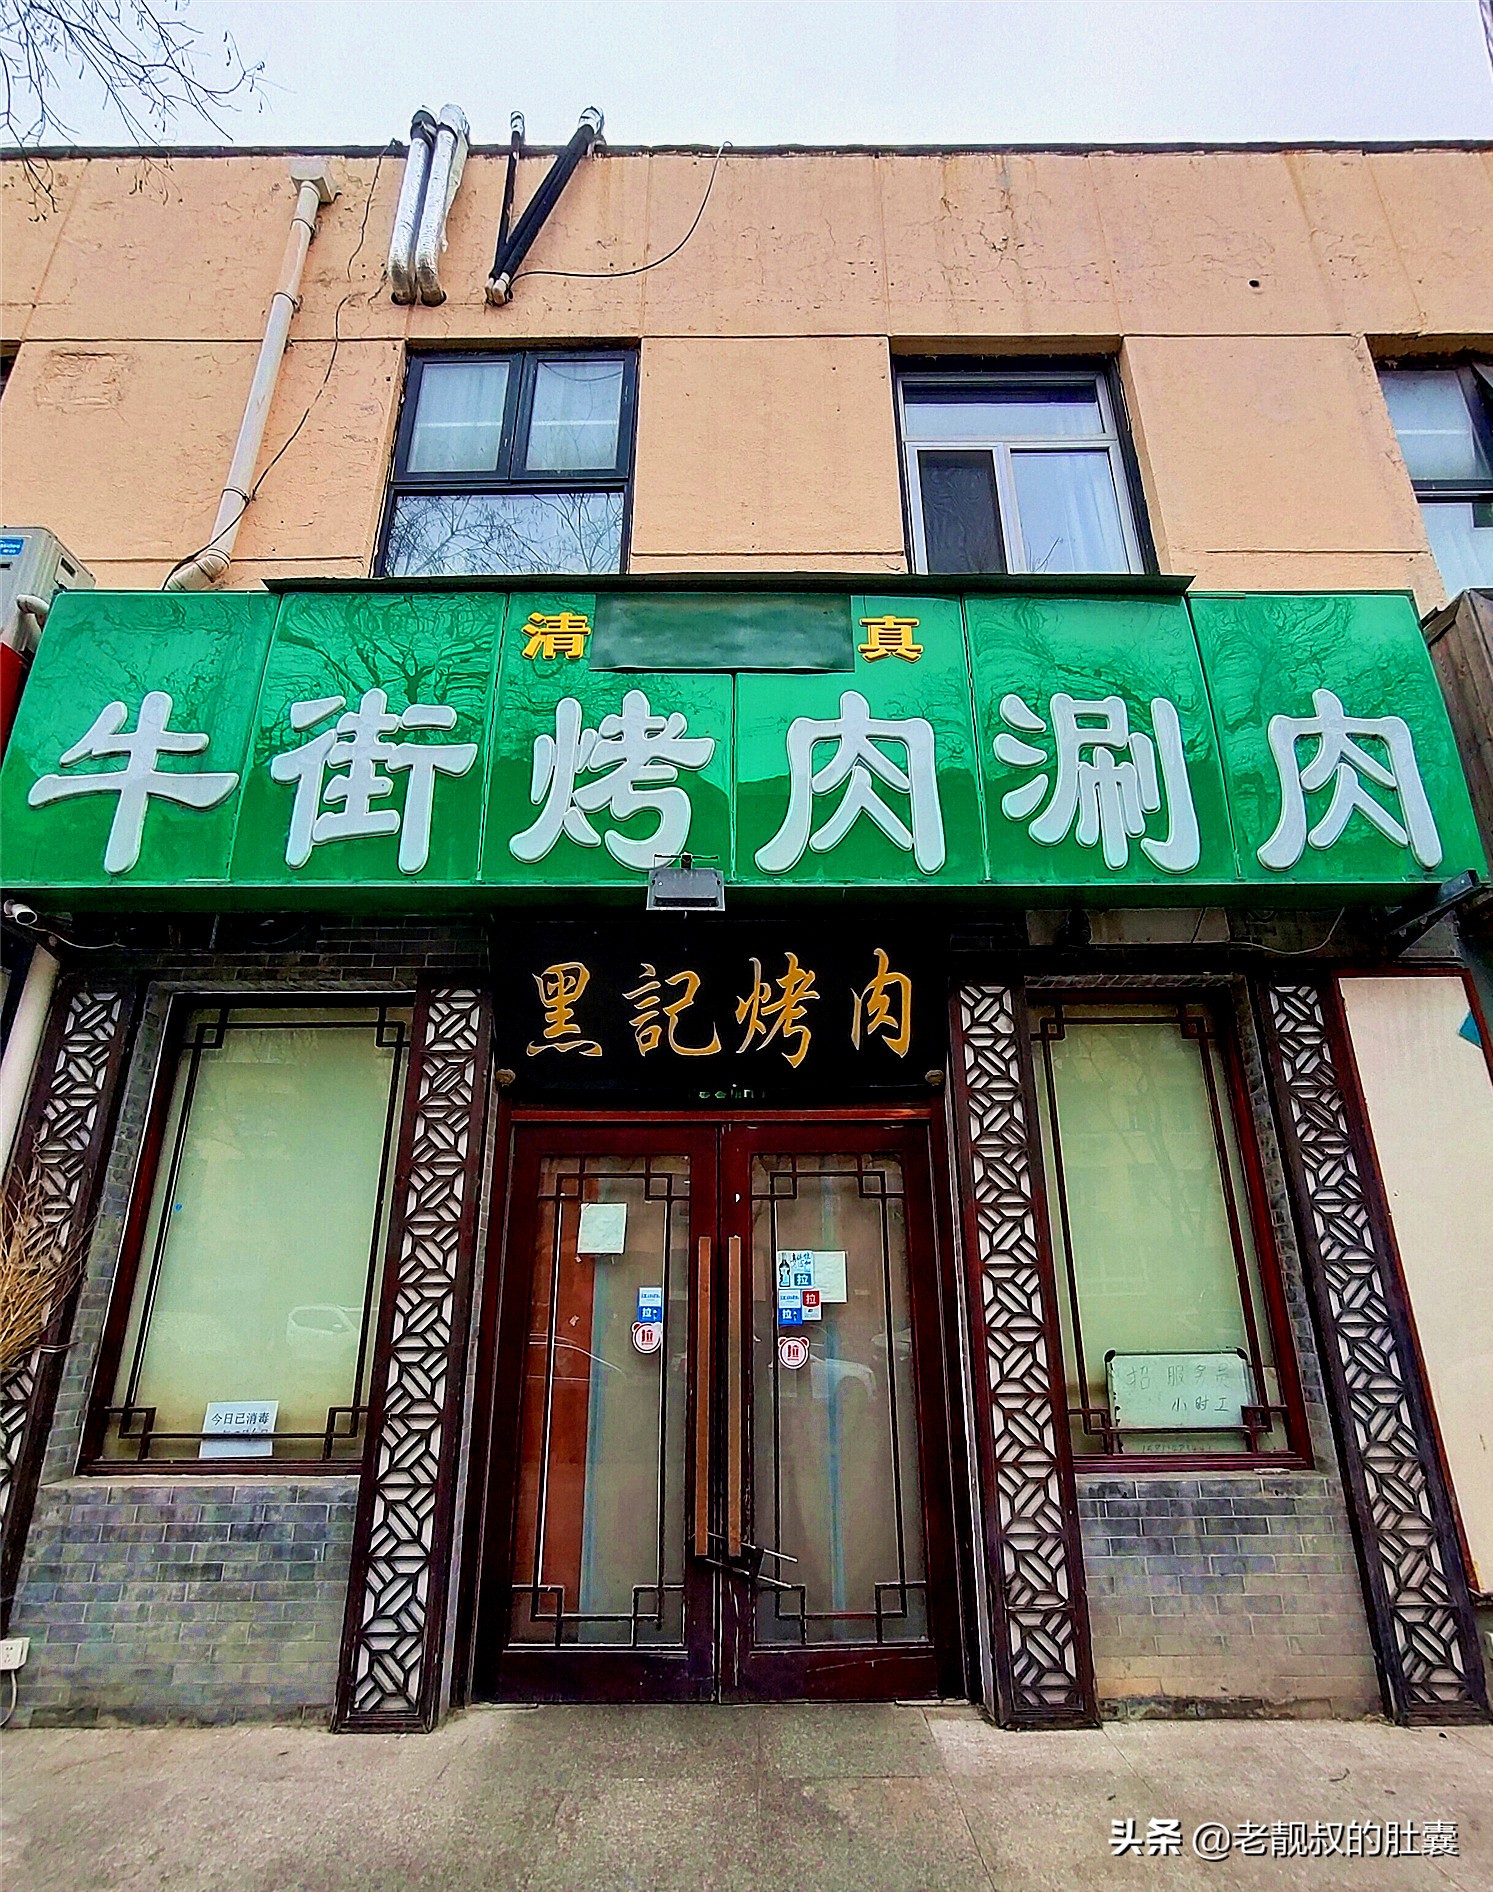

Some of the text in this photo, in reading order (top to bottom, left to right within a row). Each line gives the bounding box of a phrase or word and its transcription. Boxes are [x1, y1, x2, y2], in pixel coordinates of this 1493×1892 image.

[522, 612, 923, 662] 清 真
[28, 688, 1444, 874] 牛街烤肉涮肉
[796, 1274, 809, 1286] 拉
[805, 1293, 817, 1305] 拉
[642, 1307, 652, 1318] 拉
[782, 1308, 793, 1320] 拉
[1172, 1396, 1229, 1412] 小时工
